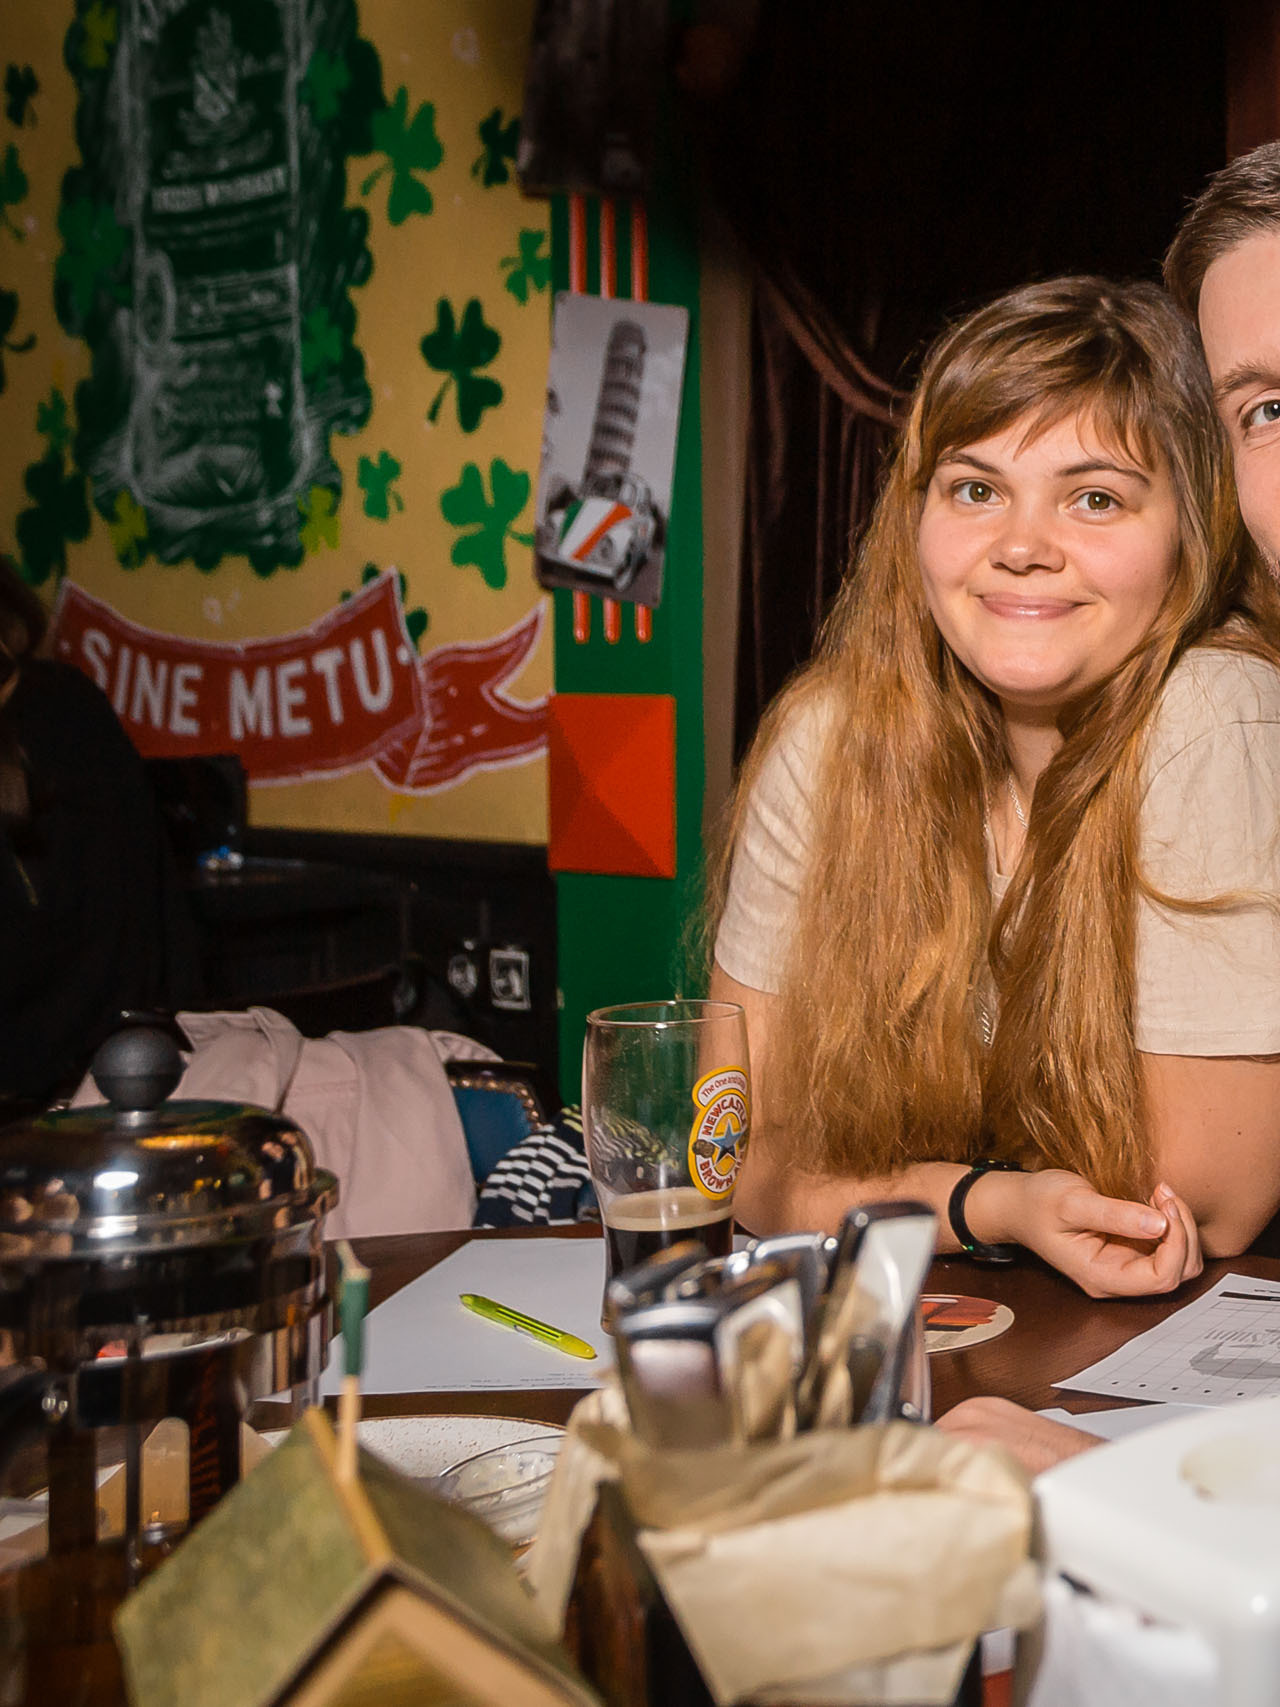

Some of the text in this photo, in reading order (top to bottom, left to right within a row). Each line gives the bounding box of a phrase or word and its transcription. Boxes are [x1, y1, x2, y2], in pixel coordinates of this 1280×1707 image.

[82, 627, 393, 740] SINE METU
[701, 1084, 715, 1097] The
[714, 1077, 727, 1088] One
[700, 1159, 733, 1190] BROWN
